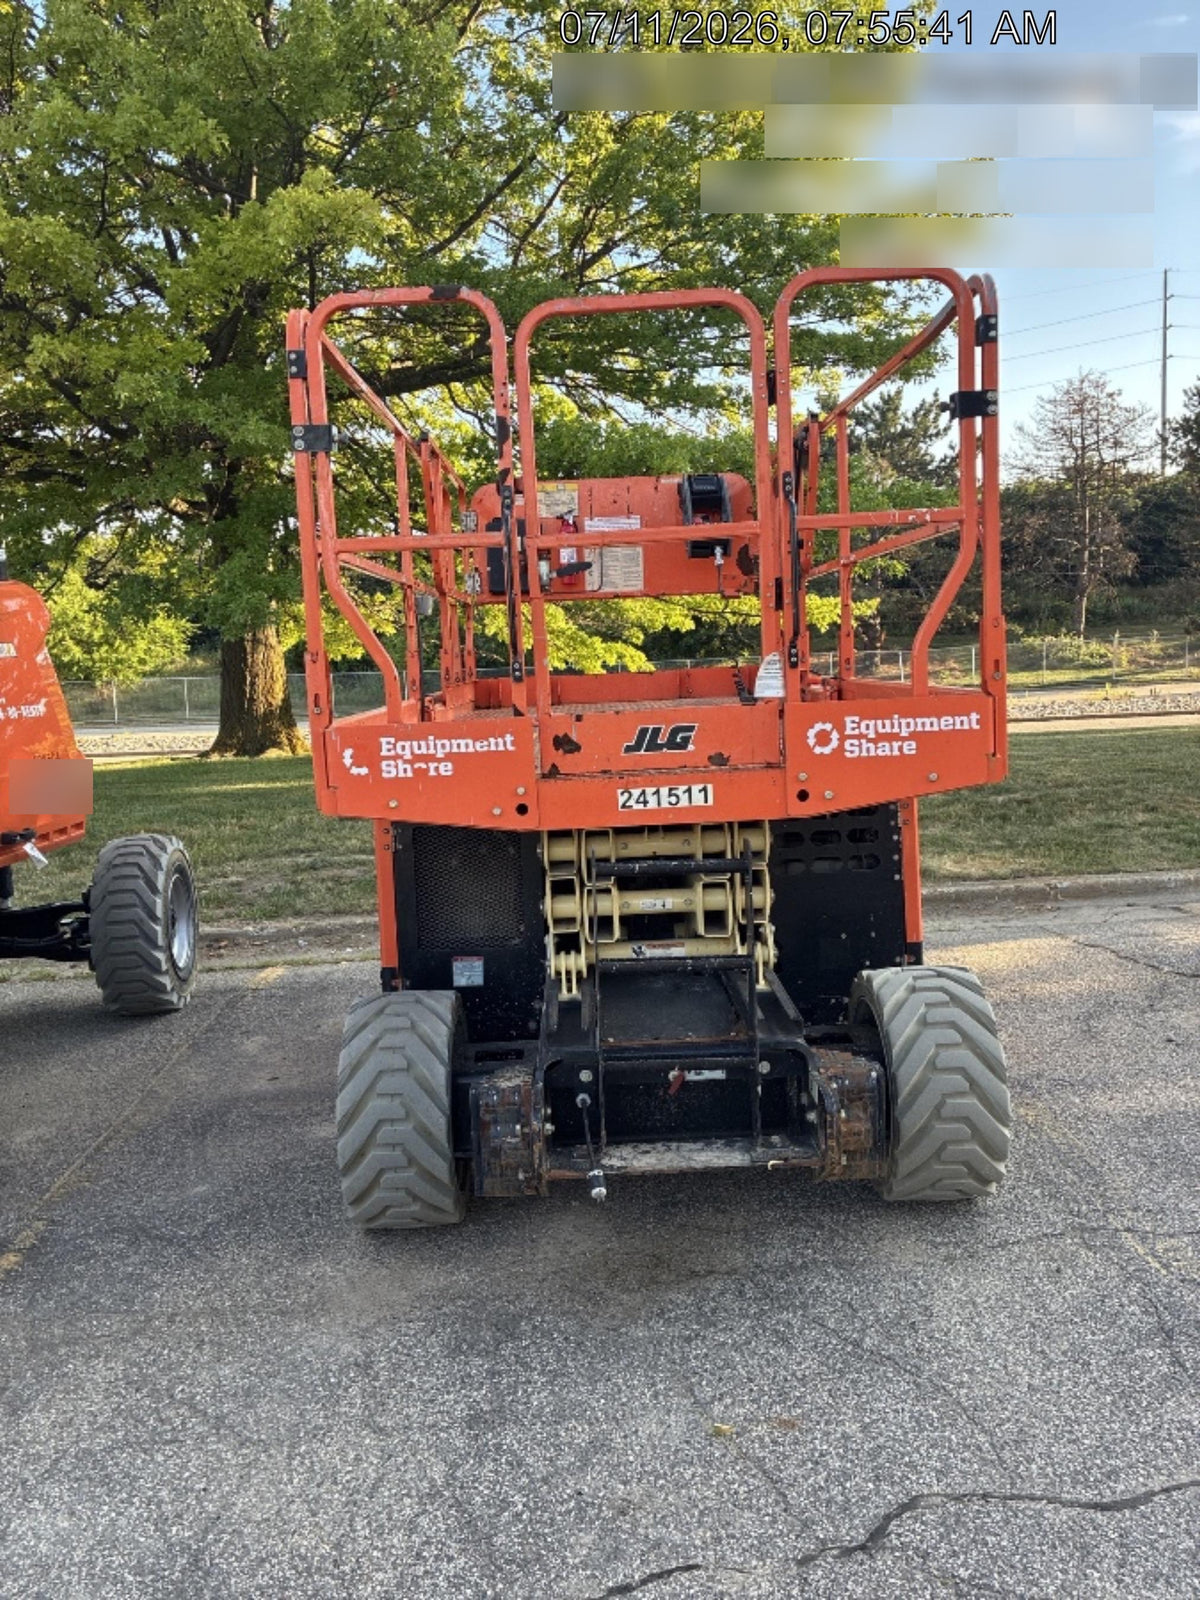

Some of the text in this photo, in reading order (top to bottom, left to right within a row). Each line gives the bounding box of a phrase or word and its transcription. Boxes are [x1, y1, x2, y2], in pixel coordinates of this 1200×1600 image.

[844, 711, 981, 736] Equipment
[379, 733, 516, 757] Equipment
[621, 723, 698, 754] JLG
[843, 738, 917, 758] Share
[380, 759, 454, 779] Shre
[619, 784, 712, 810] 241511
